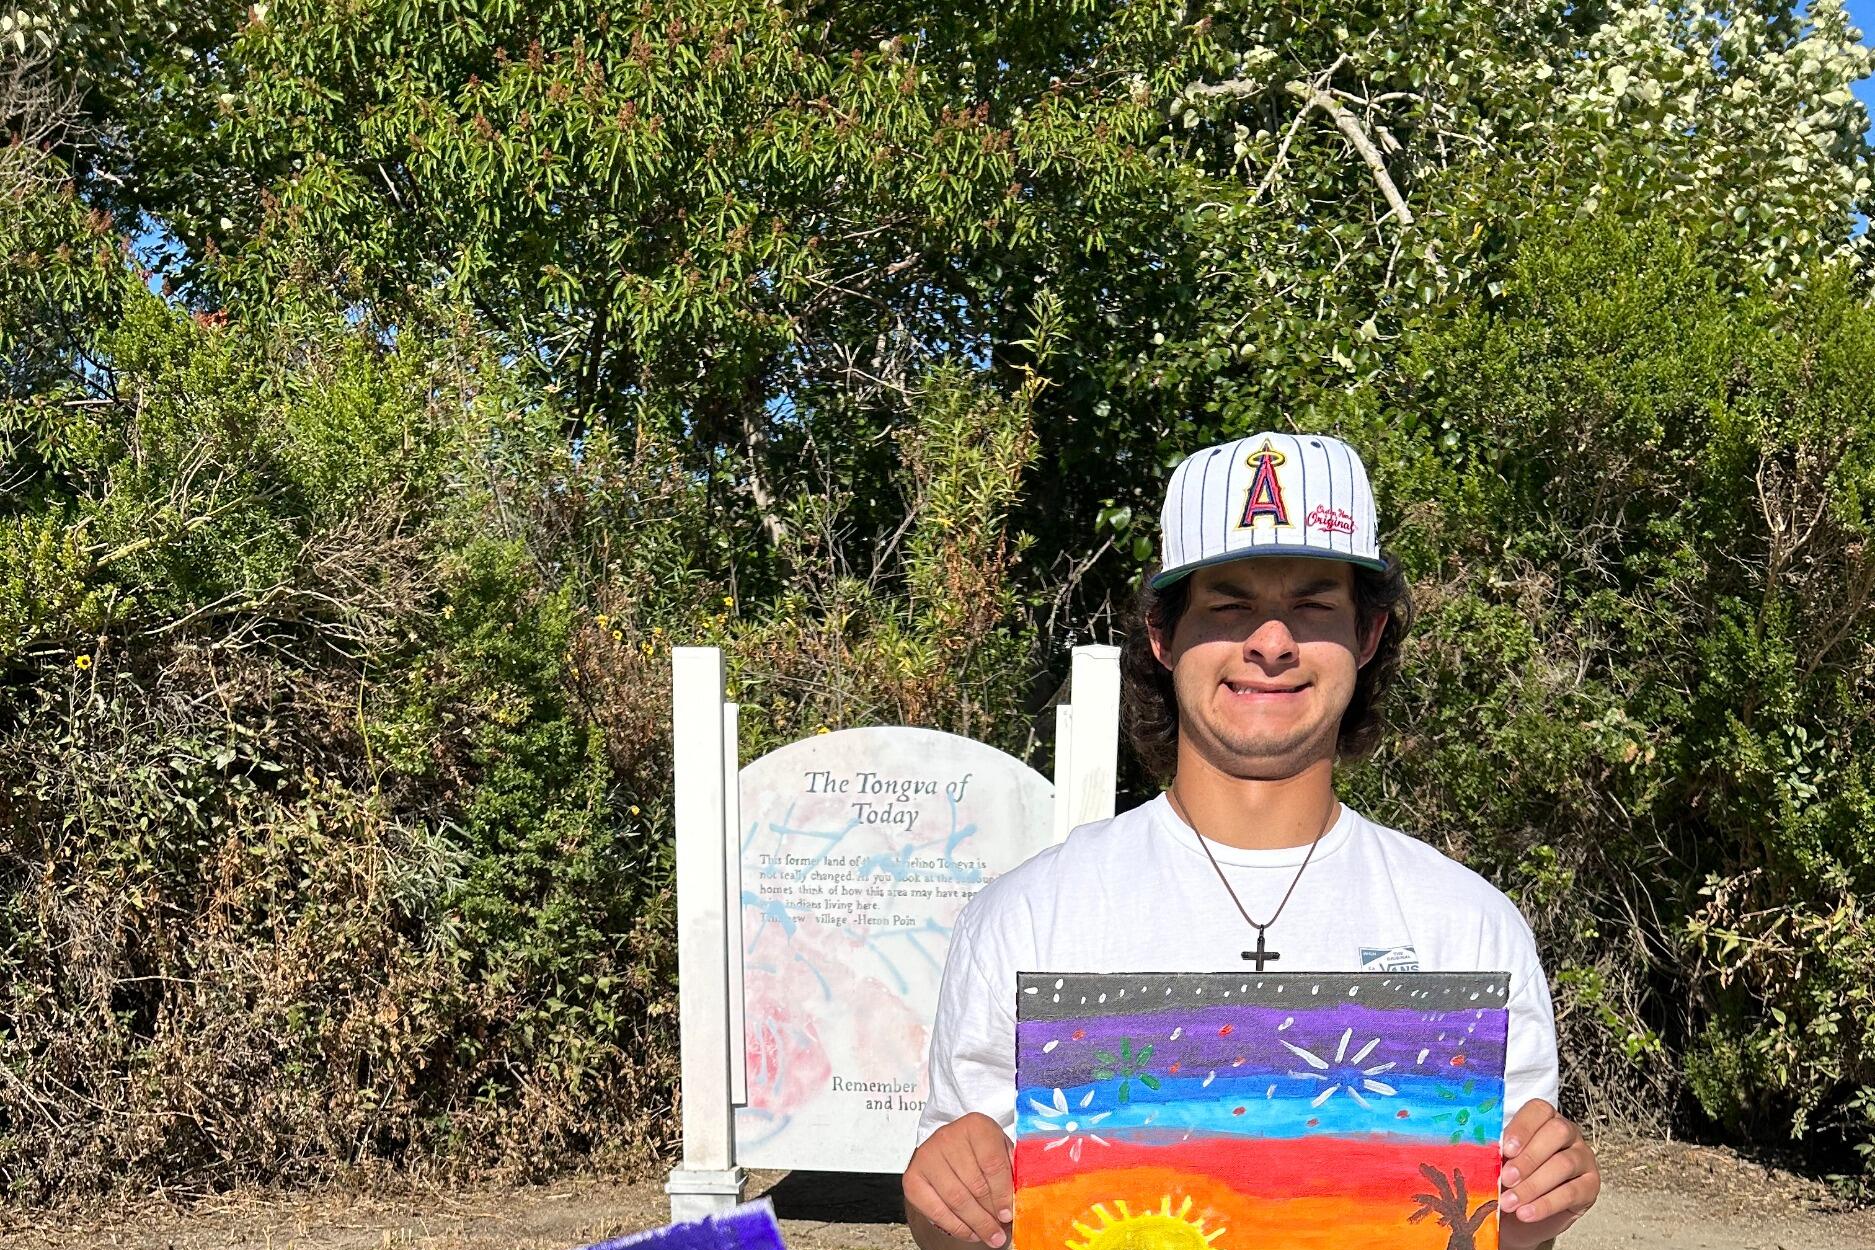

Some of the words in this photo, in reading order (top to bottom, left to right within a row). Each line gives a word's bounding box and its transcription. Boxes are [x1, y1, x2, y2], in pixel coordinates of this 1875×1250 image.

[1236, 439, 1292, 529] A
[804, 771, 849, 793] The
[855, 772, 938, 803] Tongva
[946, 773, 973, 803] of
[851, 802, 919, 832] Today
[823, 856, 846, 867] land
[849, 855, 861, 867] of
[977, 857, 987, 869] is
[873, 874, 891, 885] you
[760, 884, 793, 895] homes
[799, 885, 823, 895] think
[828, 885, 838, 895] of
[841, 885, 863, 896] how
[866, 886, 885, 897] this
[888, 889, 908, 897] area
[911, 890, 932, 900] may
[936, 887, 958, 898] have
[824, 899, 852, 913] living
[816, 913, 847, 927] village
[832, 1076, 918, 1093] Remember
[866, 1096, 893, 1110] and
